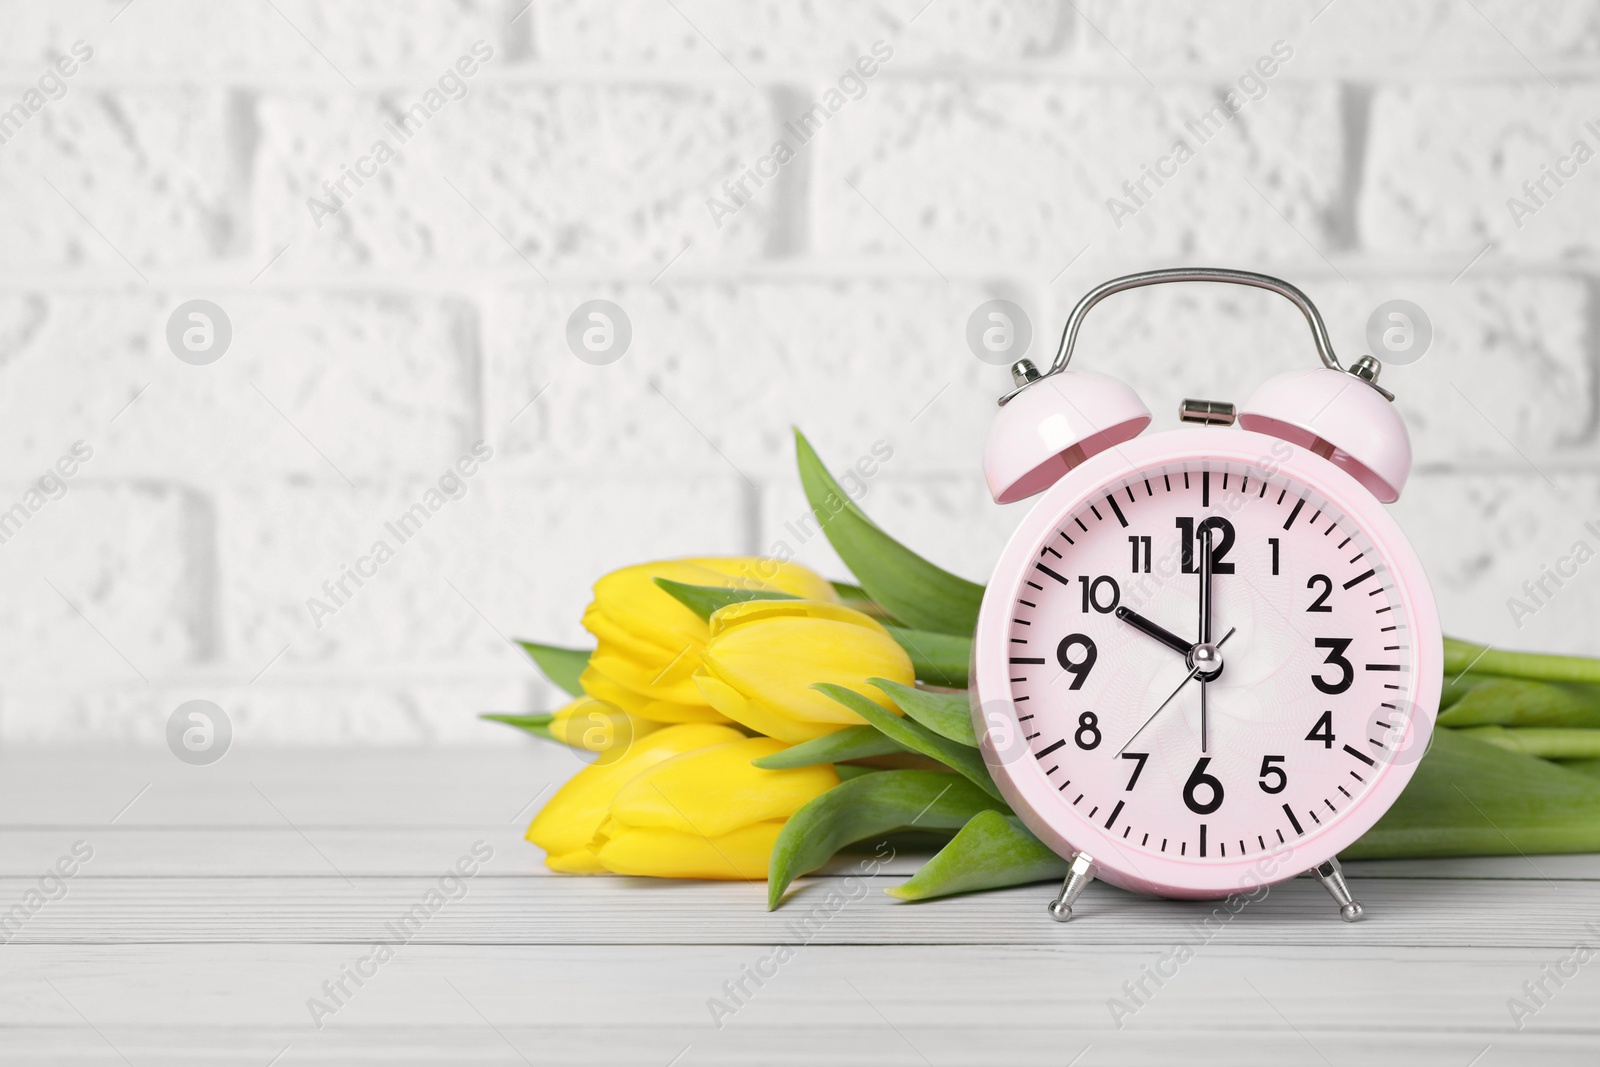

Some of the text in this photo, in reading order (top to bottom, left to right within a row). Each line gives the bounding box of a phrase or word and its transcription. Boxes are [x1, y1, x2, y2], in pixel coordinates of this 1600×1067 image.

[1128, 536, 1151, 573] 11
[1175, 516, 1235, 574] 12
[1268, 538, 1279, 575] 1
[1079, 575, 1120, 613] 10
[1306, 574, 1332, 612] 2
[1057, 633, 1097, 690] 9
[1311, 638, 1354, 695] 3
[1075, 711, 1101, 750] 8
[1304, 711, 1335, 748] 4
[1122, 753, 1149, 791] 7
[1183, 758, 1224, 815] 6
[1259, 756, 1287, 794] 5
